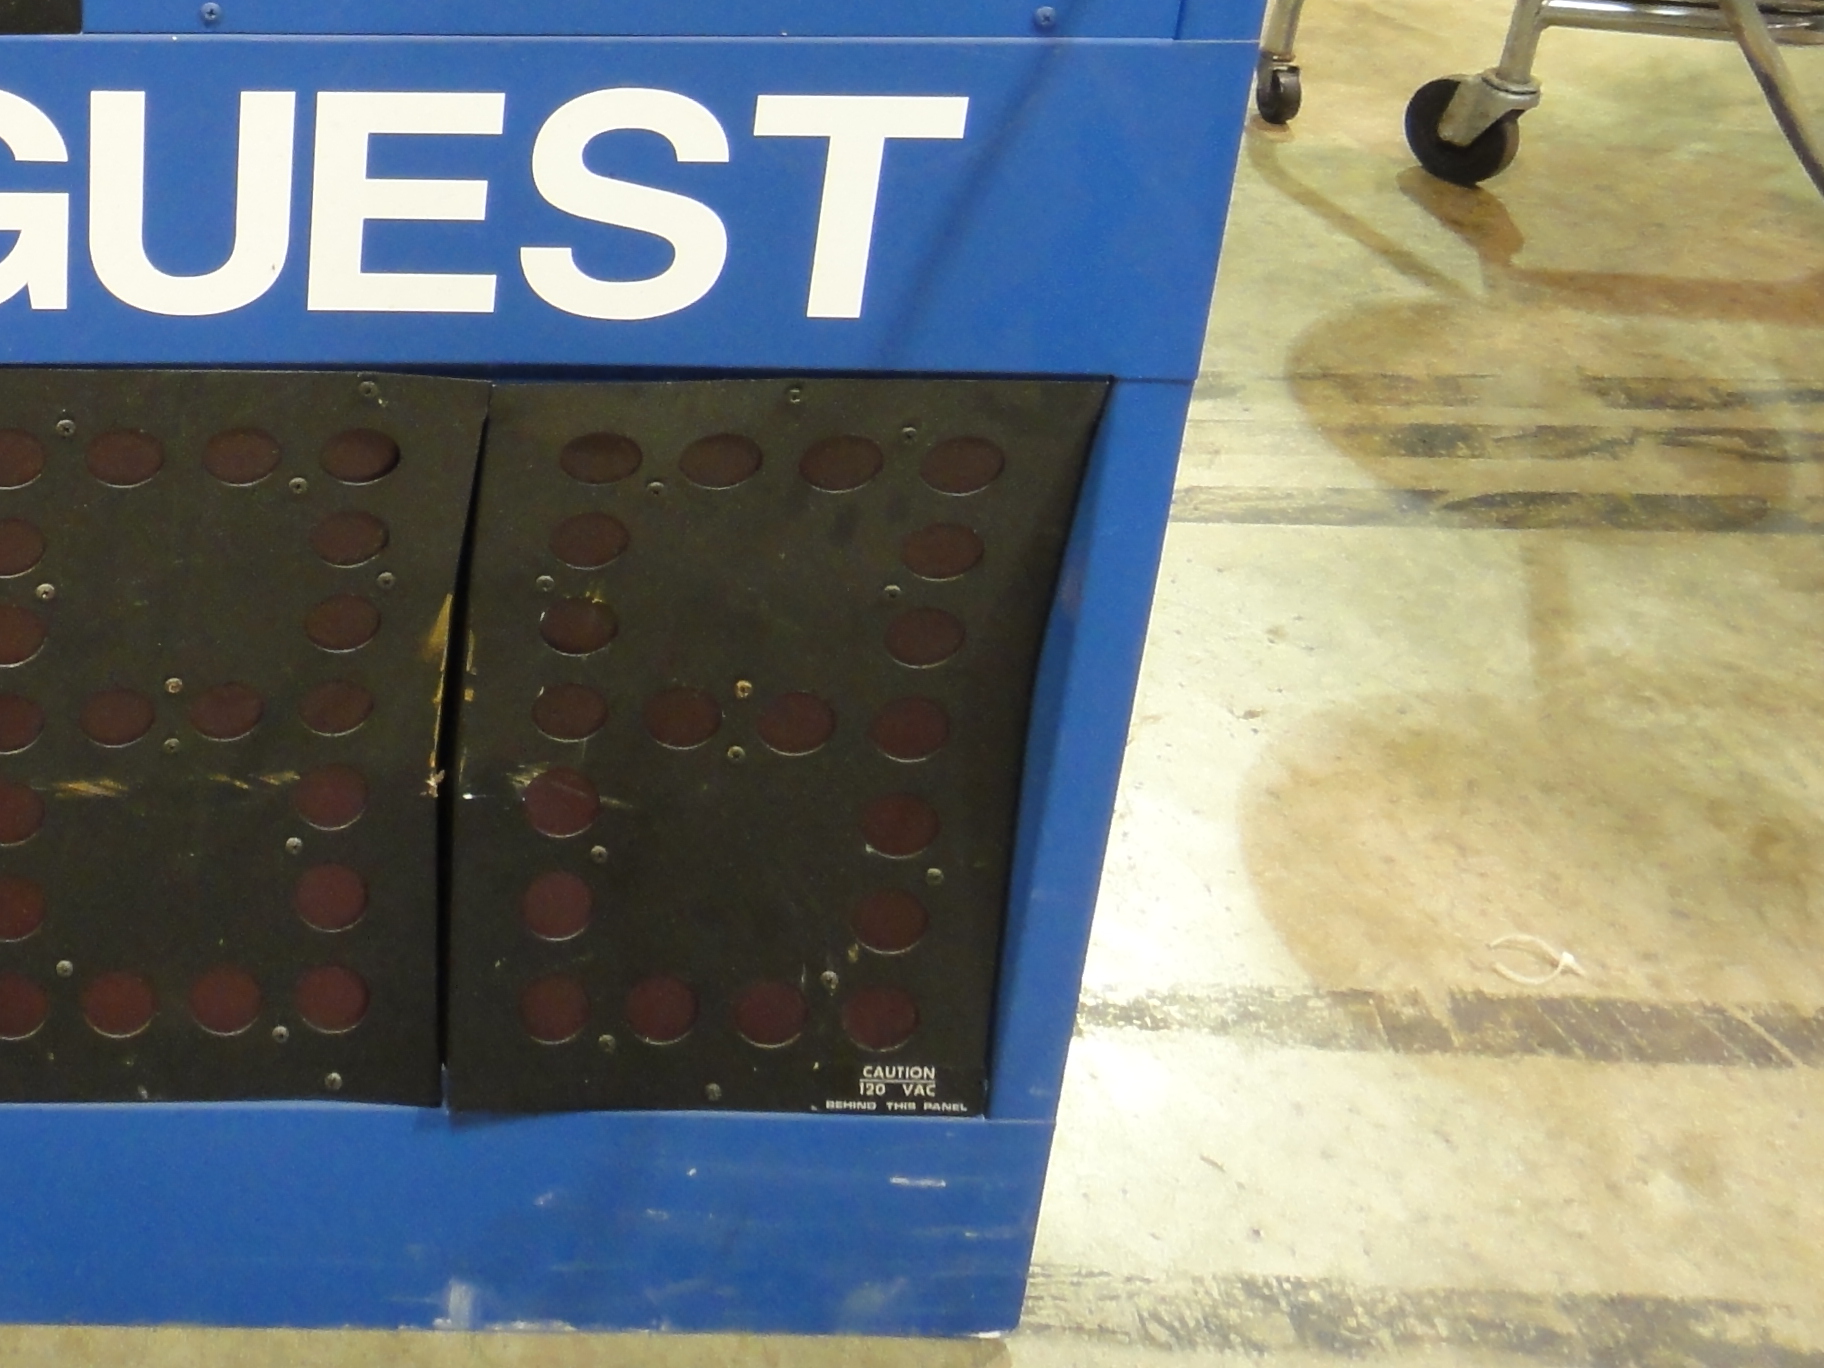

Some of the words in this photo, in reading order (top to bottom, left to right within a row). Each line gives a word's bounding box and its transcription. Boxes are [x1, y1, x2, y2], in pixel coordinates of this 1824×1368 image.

[862, 1065, 936, 1080] CAUTION
[859, 1083, 886, 1096] 120
[902, 1083, 936, 1097] VAC
[825, 1099, 877, 1111] BEHIND
[886, 1101, 917, 1111] THIS
[923, 1102, 968, 1112] PANEL
